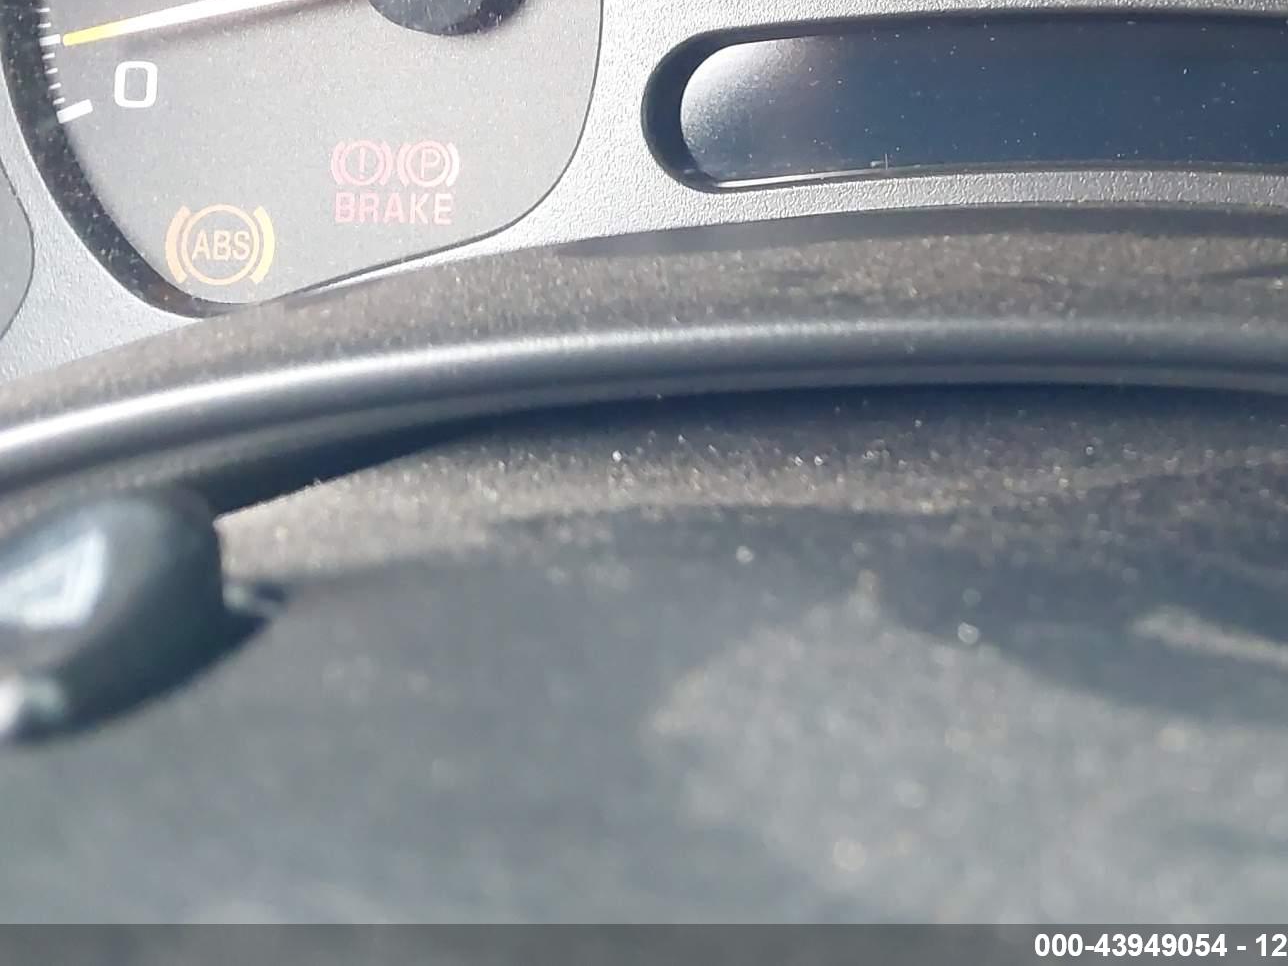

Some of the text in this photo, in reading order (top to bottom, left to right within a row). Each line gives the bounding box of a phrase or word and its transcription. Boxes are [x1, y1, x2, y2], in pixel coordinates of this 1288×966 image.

[113, 60, 158, 109] 0
[334, 191, 453, 226] BRAKE
[191, 228, 251, 261] ABS
